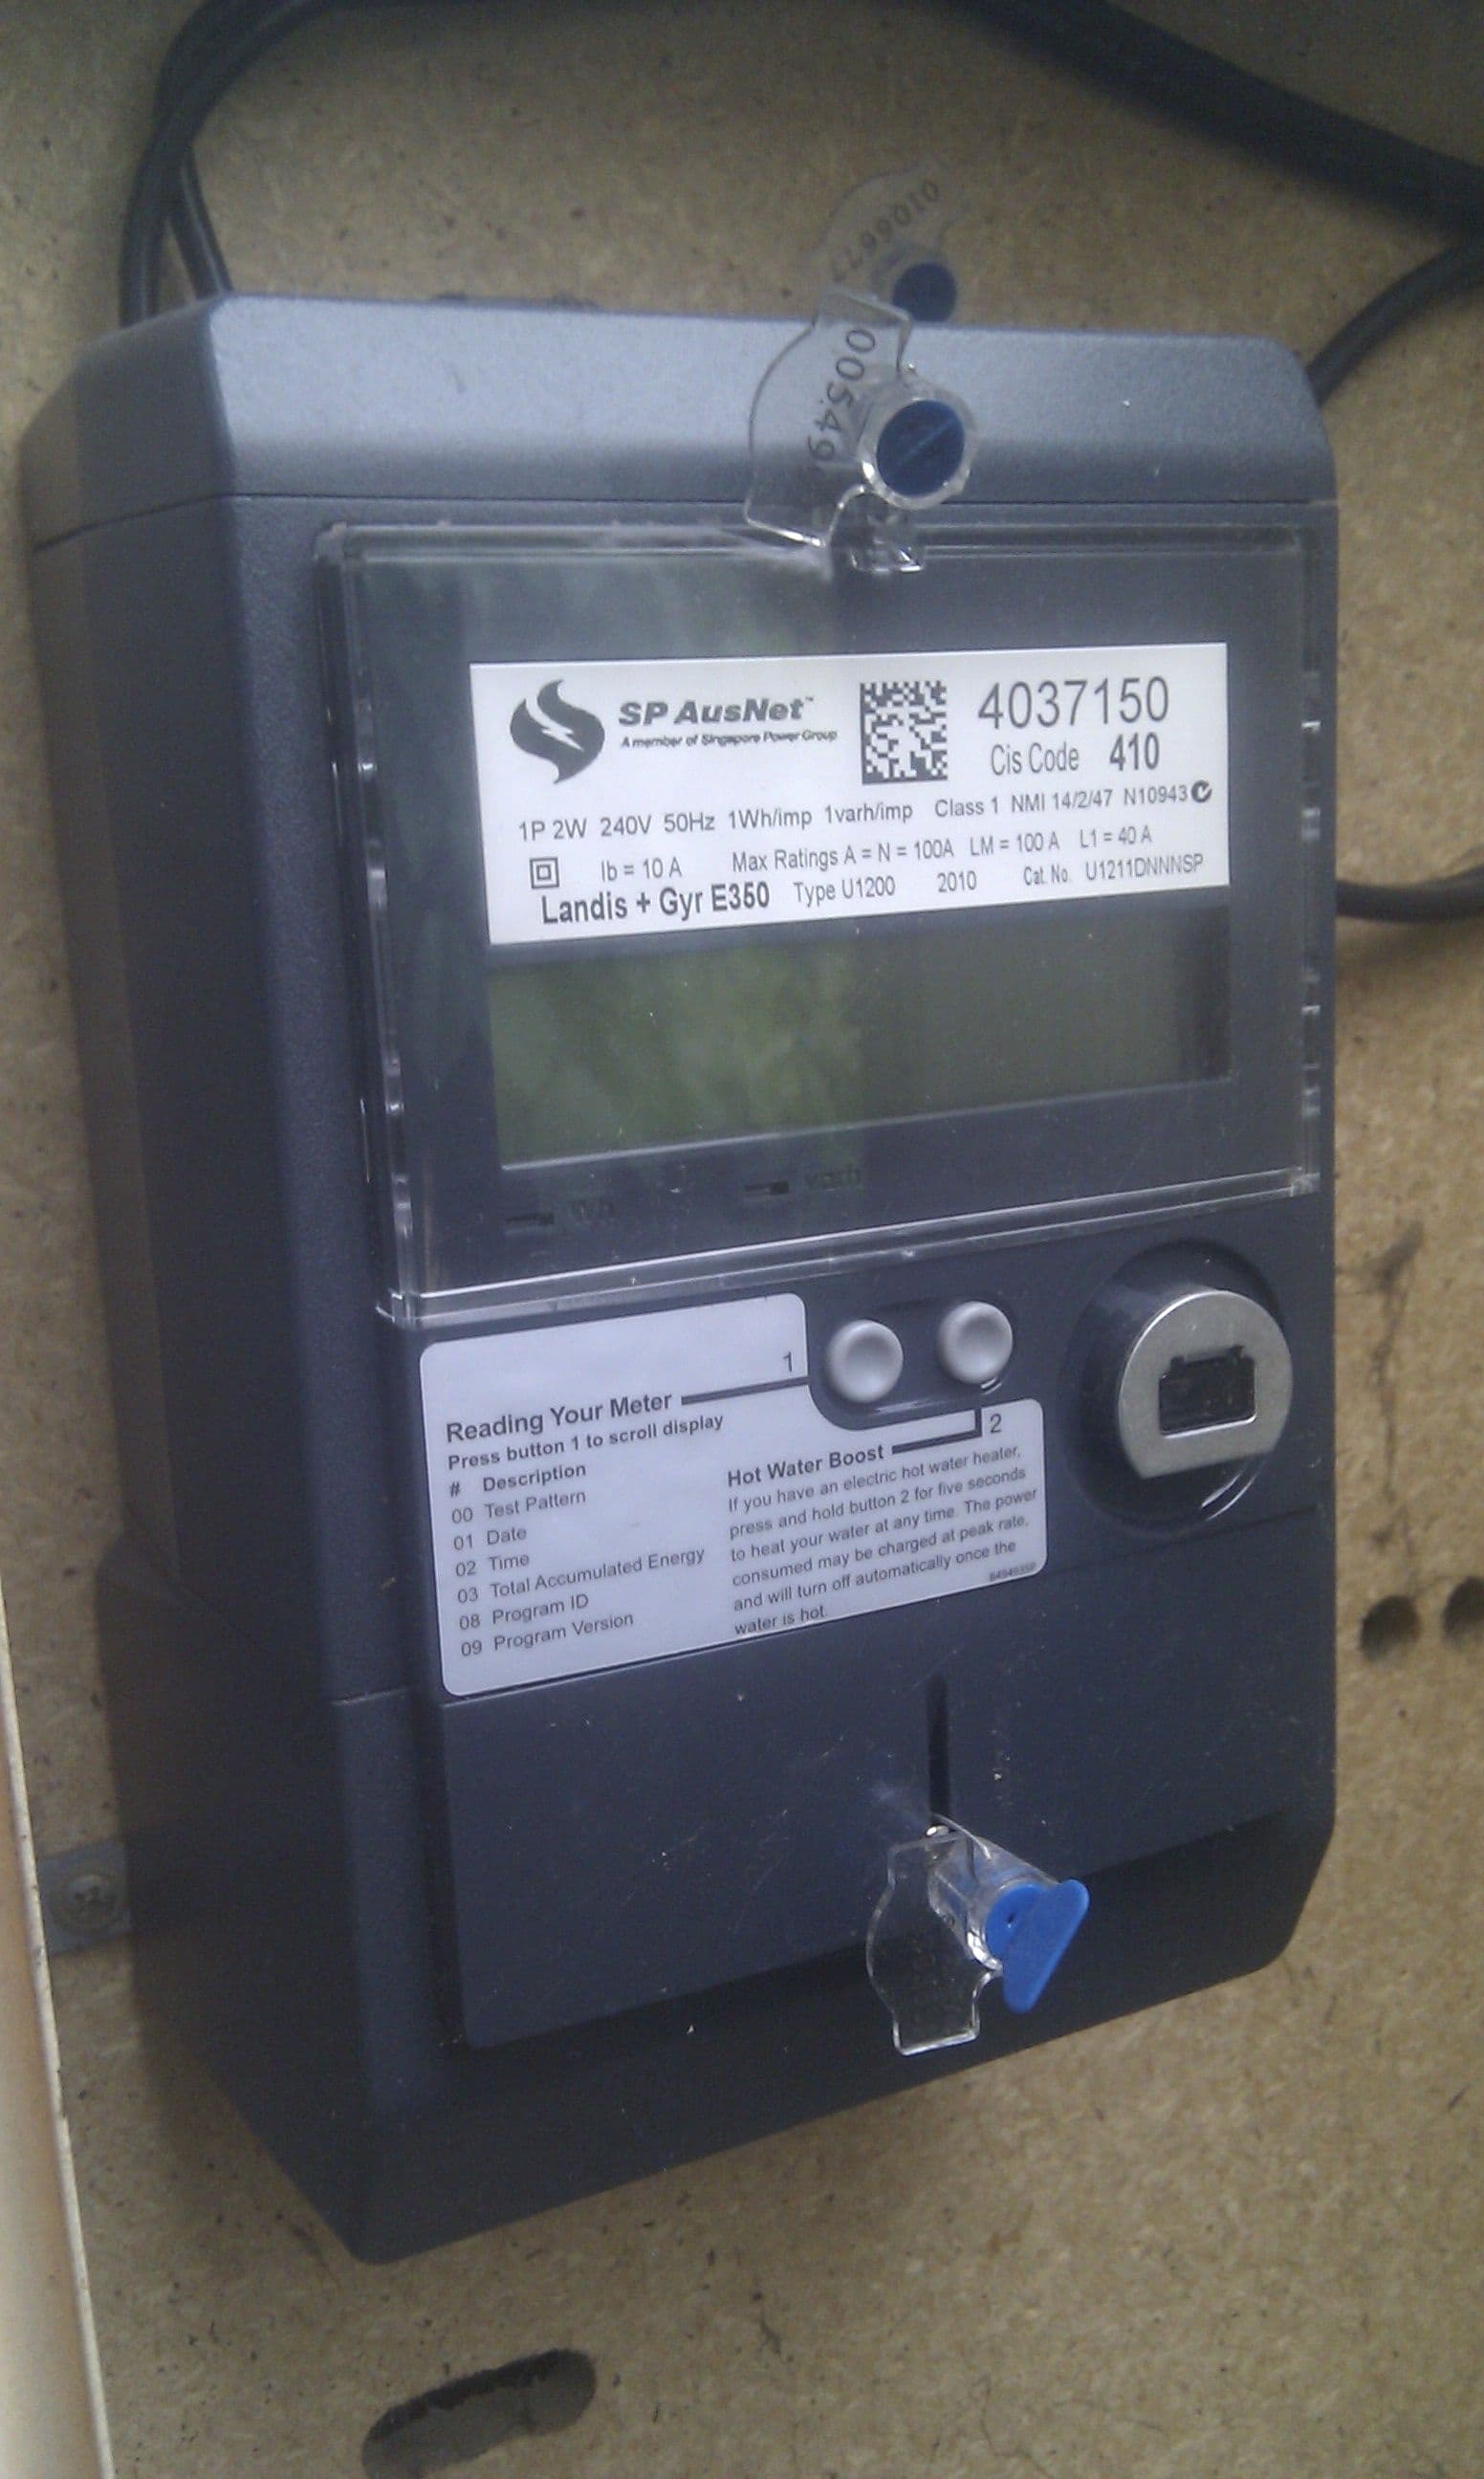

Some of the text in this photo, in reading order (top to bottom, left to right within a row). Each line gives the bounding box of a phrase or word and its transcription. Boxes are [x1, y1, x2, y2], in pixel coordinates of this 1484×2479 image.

[619, 701, 668, 726] SP
[978, 676, 1169, 729] 4037150
[622, 730, 837, 748] A member of Singapore Power Group
[991, 732, 1160, 777] Cis Code 410
[519, 822, 545, 841] 1P
[554, 819, 586, 839] 2W
[600, 816, 651, 836] 240V
[665, 813, 714, 832] 50Hz
[729, 808, 813, 830] 1Wh/imp
[825, 800, 913, 823] 1varh/imp
[935, 798, 984, 818] Class
[991, 797, 998, 814] 1
[1012, 792, 1045, 812] NMI
[1053, 789, 1113, 809] 14/2/47
[624, 865, 635, 875] =
[644, 859, 664, 880] 10
[669, 859, 683, 877] A
[732, 851, 767, 872] Max
[775, 846, 838, 872] Ratings
[843, 845, 856, 863] A
[862, 849, 871, 858] =
[878, 843, 891, 861] N
[897, 847, 906, 856] =
[913, 840, 953, 859] 100A
[971, 836, 993, 856] LM
[1015, 834, 1043, 852] 100
[1048, 833, 1058, 849] A
[1080, 830, 1097, 848] L1
[1118, 827, 1135, 845] 40
[1141, 825, 1152, 843] A
[541, 891, 628, 924] Landis
[636, 893, 650, 914] +
[660, 887, 703, 921] Gyr
[711, 882, 770, 912] E350
[794, 878, 836, 907] Type
[841, 876, 895, 899] U1200
[937, 870, 977, 893] 2010
[1085, 853, 1203, 881] U1211DNNNSP
[782, 1351, 793, 1372] 1
[446, 1393, 672, 1442] Reading Your Meter
[990, 1414, 1002, 1434] 2
[448, 1414, 724, 1471] Press button 1 to scroll display
[449, 1463, 586, 1499] # Description
[728, 1445, 884, 1487] Hot Water Boost
[743, 1496, 772, 1514] you
[777, 1486, 814, 1505] have
[819, 1481, 839, 1496] an
[844, 1468, 897, 1491] electric
[902, 1465, 925, 1481] hot
[928, 1459, 968, 1475] water
[451, 1489, 586, 1525] 00 Test Pattern
[730, 1467, 1026, 1539] press and hold button 2 for five seconds
[731, 1548, 745, 1562] to
[751, 1539, 785, 1558] heat
[790, 1534, 823, 1554] your
[829, 1527, 870, 1544] water
[875, 1521, 888, 1534] at
[893, 1514, 920, 1532] any
[964, 1500, 991, 1515] The
[995, 1488, 1037, 1512] power
[453, 1526, 527, 1551] 01 Date
[732, 1559, 813, 1586] consumed
[818, 1550, 849, 1571] may
[855, 1547, 873, 1561] be
[878, 1531, 937, 1558] charged
[941, 1530, 956, 1544] at
[960, 1522, 993, 1545] peak
[455, 1553, 530, 1577] 02 Time
[457, 1547, 705, 1605] 03 Total Accumulated Energy
[734, 1541, 1016, 1612] and will turn off automatically once the
[459, 1593, 589, 1631] 08 Program ID
[461, 1612, 634, 1656] 09 Program Version
[734, 1613, 777, 1634] water
[782, 1611, 795, 1625] is
